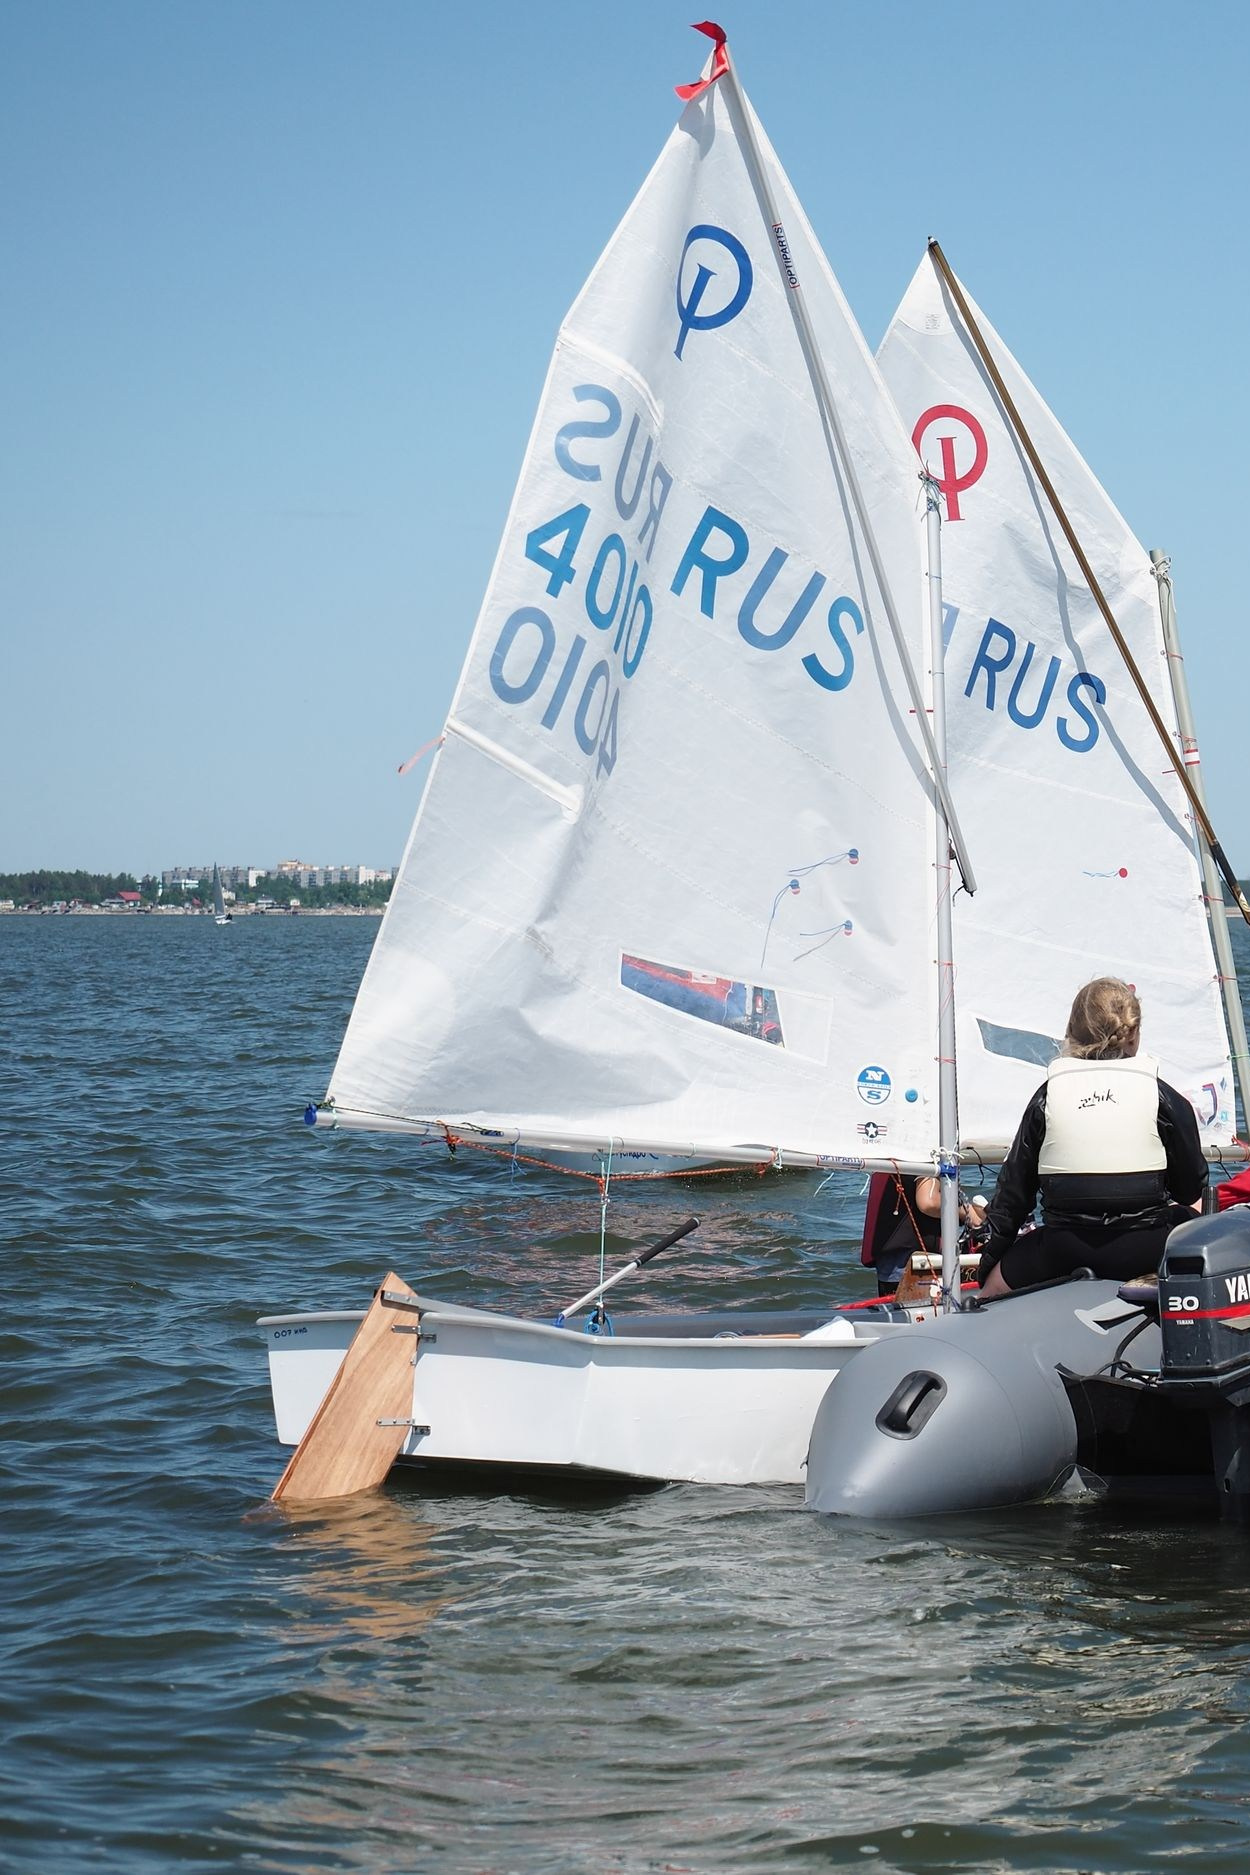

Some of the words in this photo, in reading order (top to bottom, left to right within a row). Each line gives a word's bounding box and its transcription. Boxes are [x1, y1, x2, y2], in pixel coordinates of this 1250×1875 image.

[774, 226, 798, 285] OPTIPARTS
[525, 502, 653, 680] 4010
[670, 505, 865, 692] RUS
[964, 617, 1106, 753] RUS
[1168, 1296, 1199, 1311] 30
